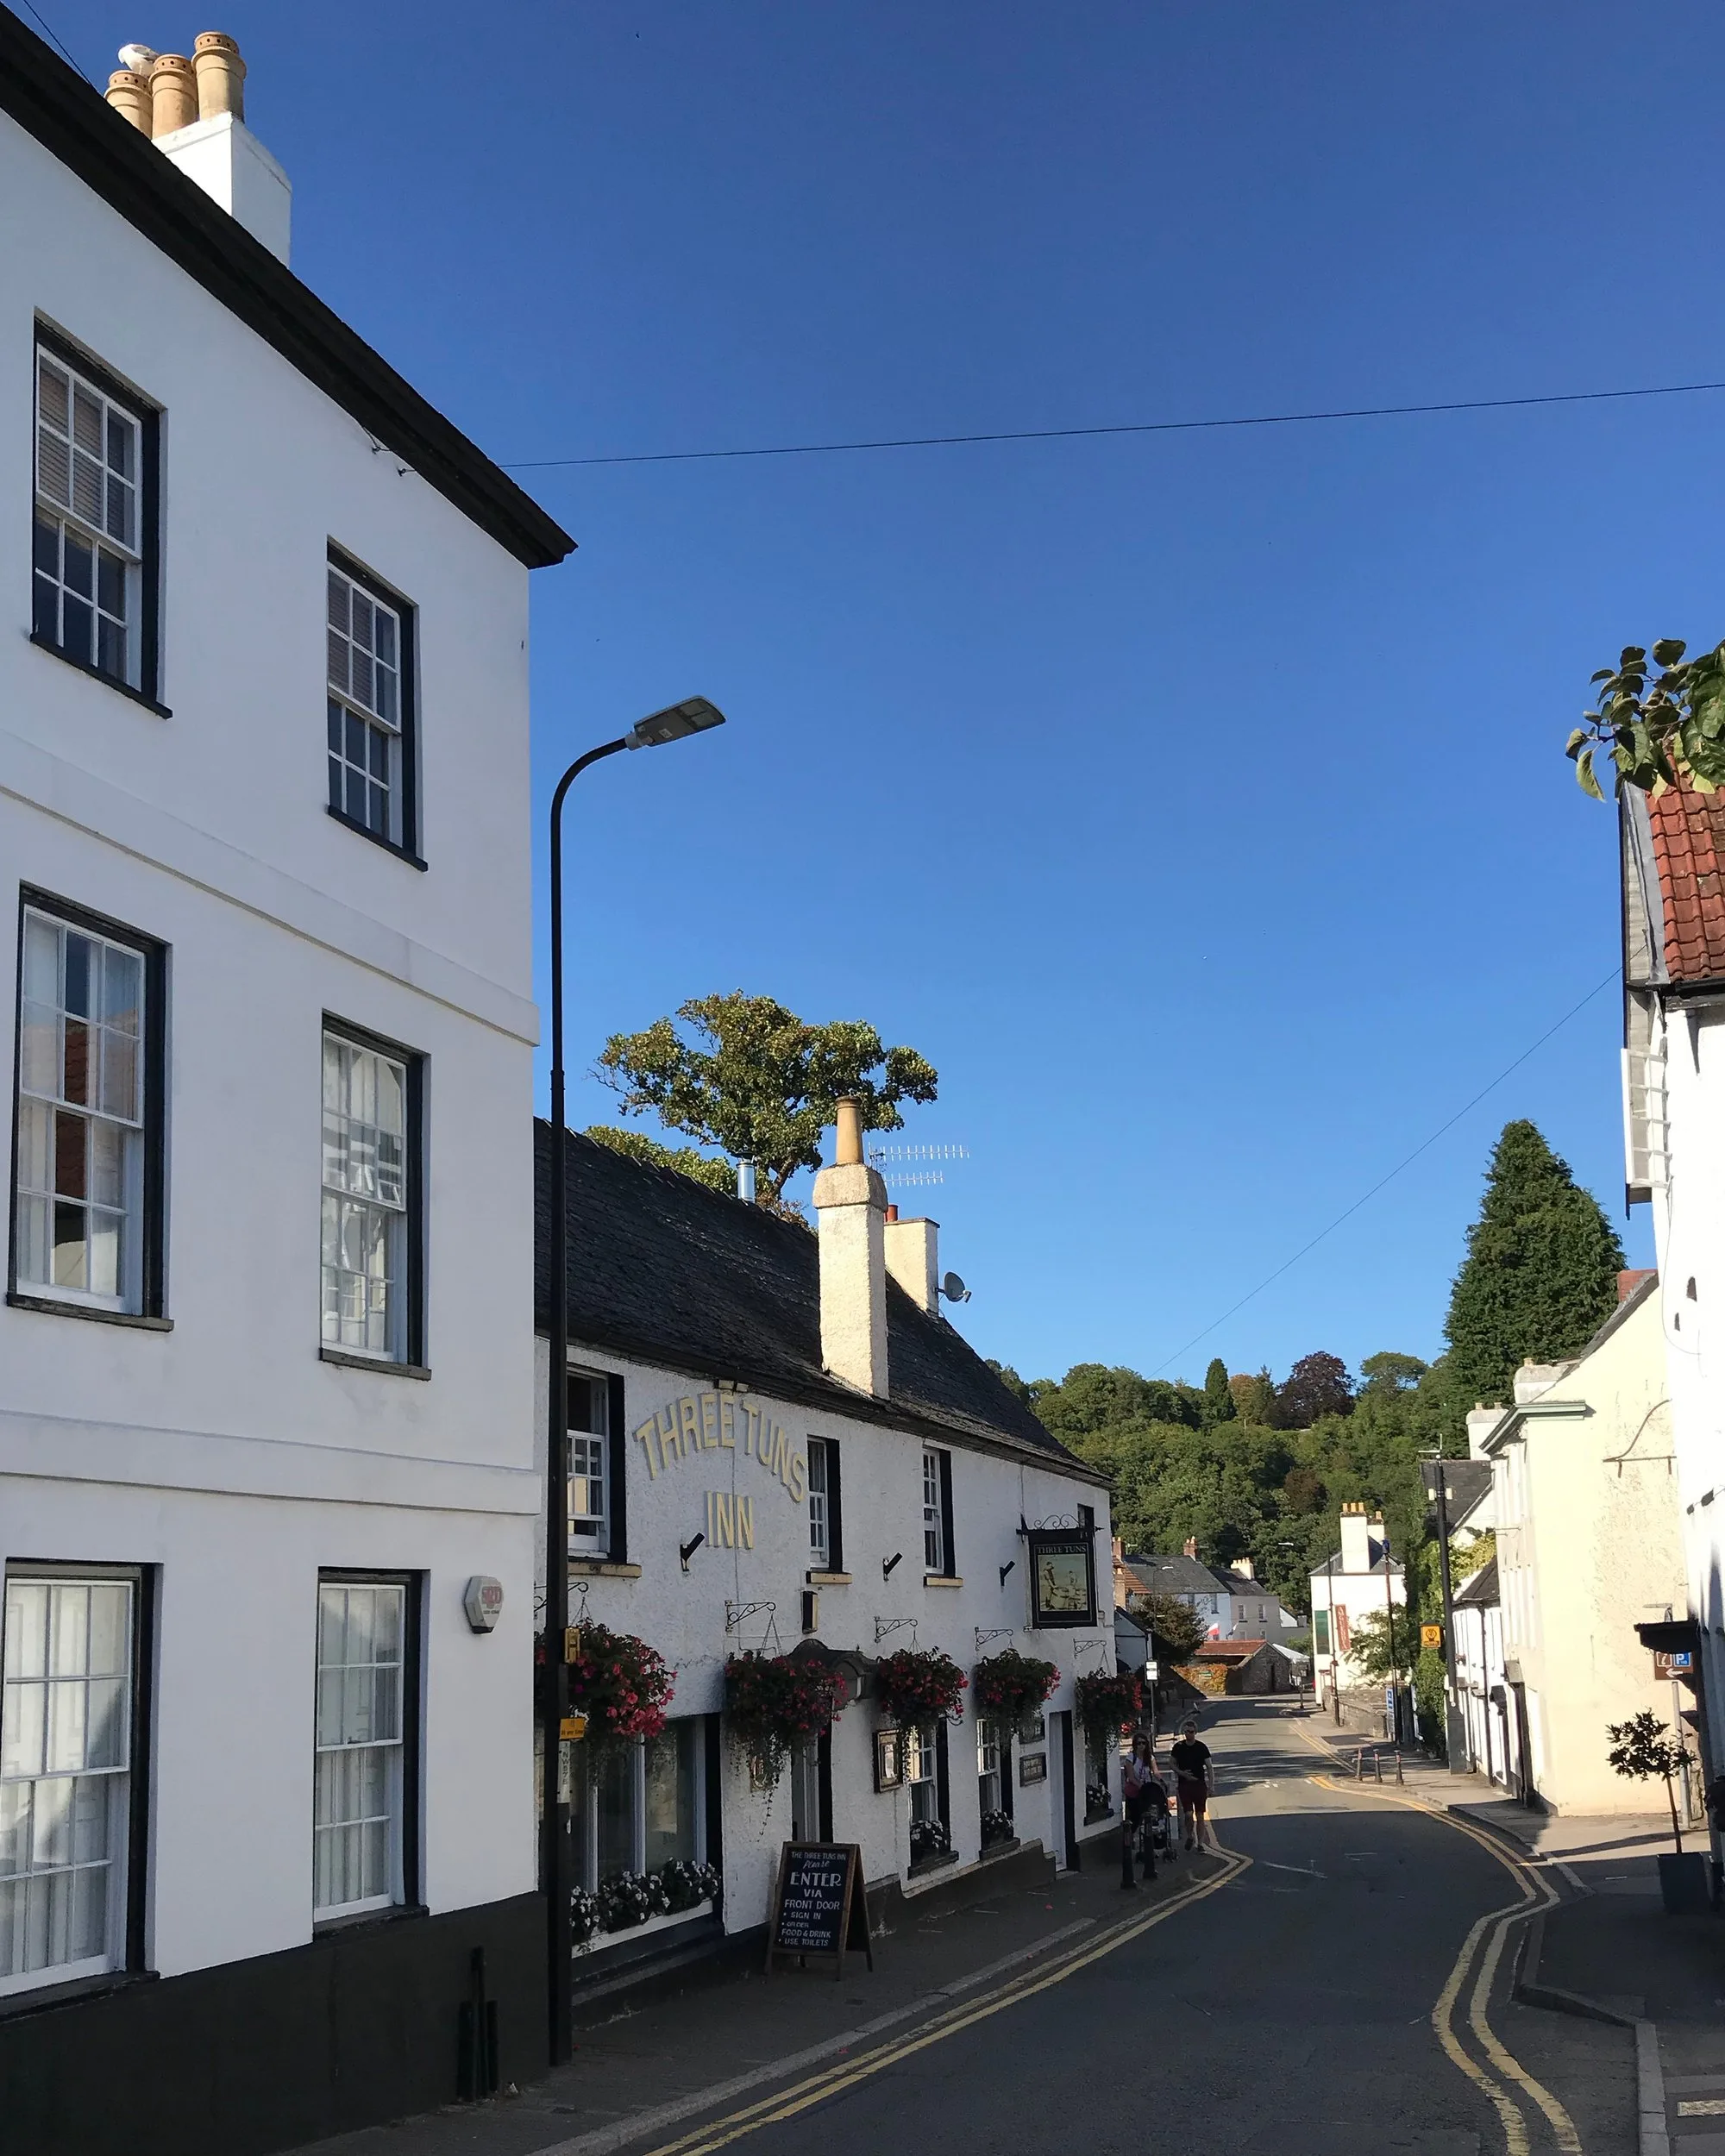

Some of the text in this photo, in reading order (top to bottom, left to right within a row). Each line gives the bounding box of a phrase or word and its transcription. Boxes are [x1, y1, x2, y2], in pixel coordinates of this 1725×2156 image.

[633, 1393, 806, 1503] THREE TUNS
[705, 1490, 756, 1550] INN
[790, 1871, 842, 1887] ENTER
[804, 1889, 822, 1898] VIA
[784, 1899, 840, 1910] FRONT DOOR
